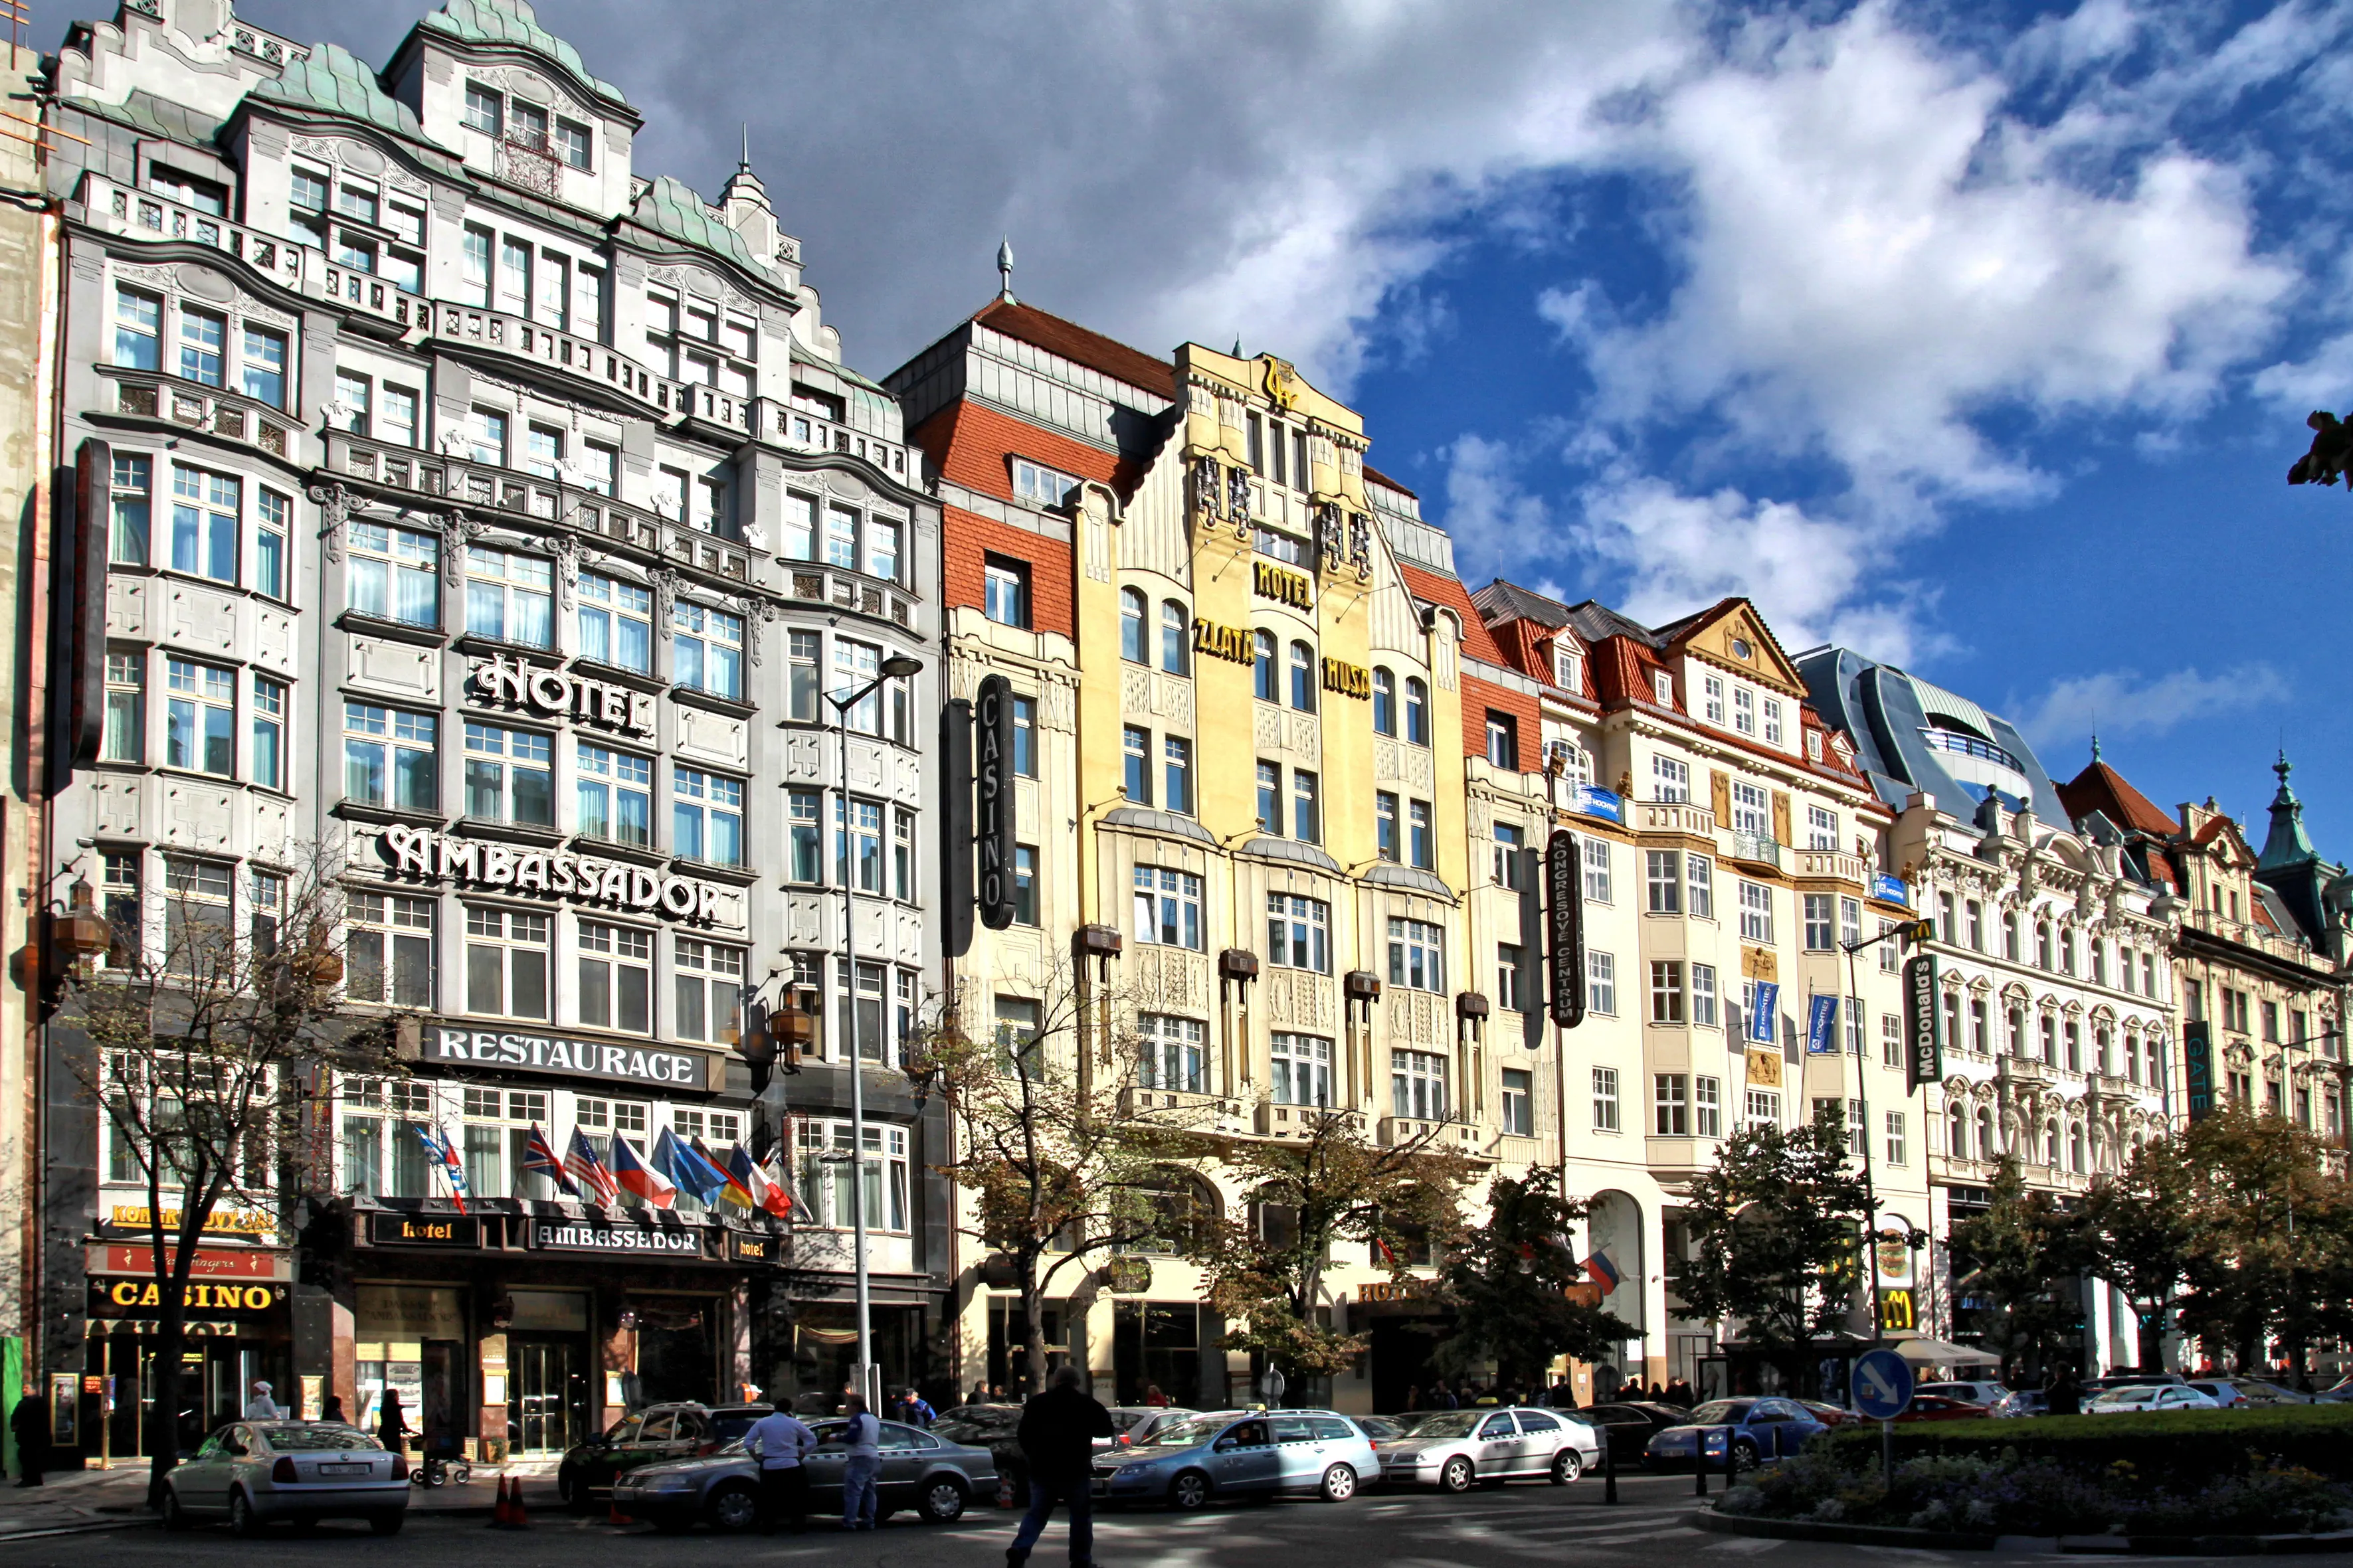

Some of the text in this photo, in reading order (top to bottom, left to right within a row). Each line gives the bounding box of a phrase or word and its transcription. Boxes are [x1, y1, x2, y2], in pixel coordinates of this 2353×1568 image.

[1256, 562, 1313, 610] HOTEL
[477, 652, 653, 731] HOTEL
[1325, 657, 1370, 699] HUSA
[983, 693, 1000, 907] CASINO
[386, 823, 723, 922] AMBASSADOR
[1557, 947, 1573, 1019] CENTRUM
[1761, 986, 1771, 1025] HOCHTIEF
[1816, 1000, 1829, 1037] HOCHTIEF
[1915, 960, 1934, 1077] McDonald's
[438, 1029, 693, 1084] RESTAURACE
[2188, 1037, 2208, 1110] GATE
[402, 1221, 452, 1239] hotel
[538, 1226, 696, 1251] AMBASSADOR
[739, 1241, 764, 1257] hotel
